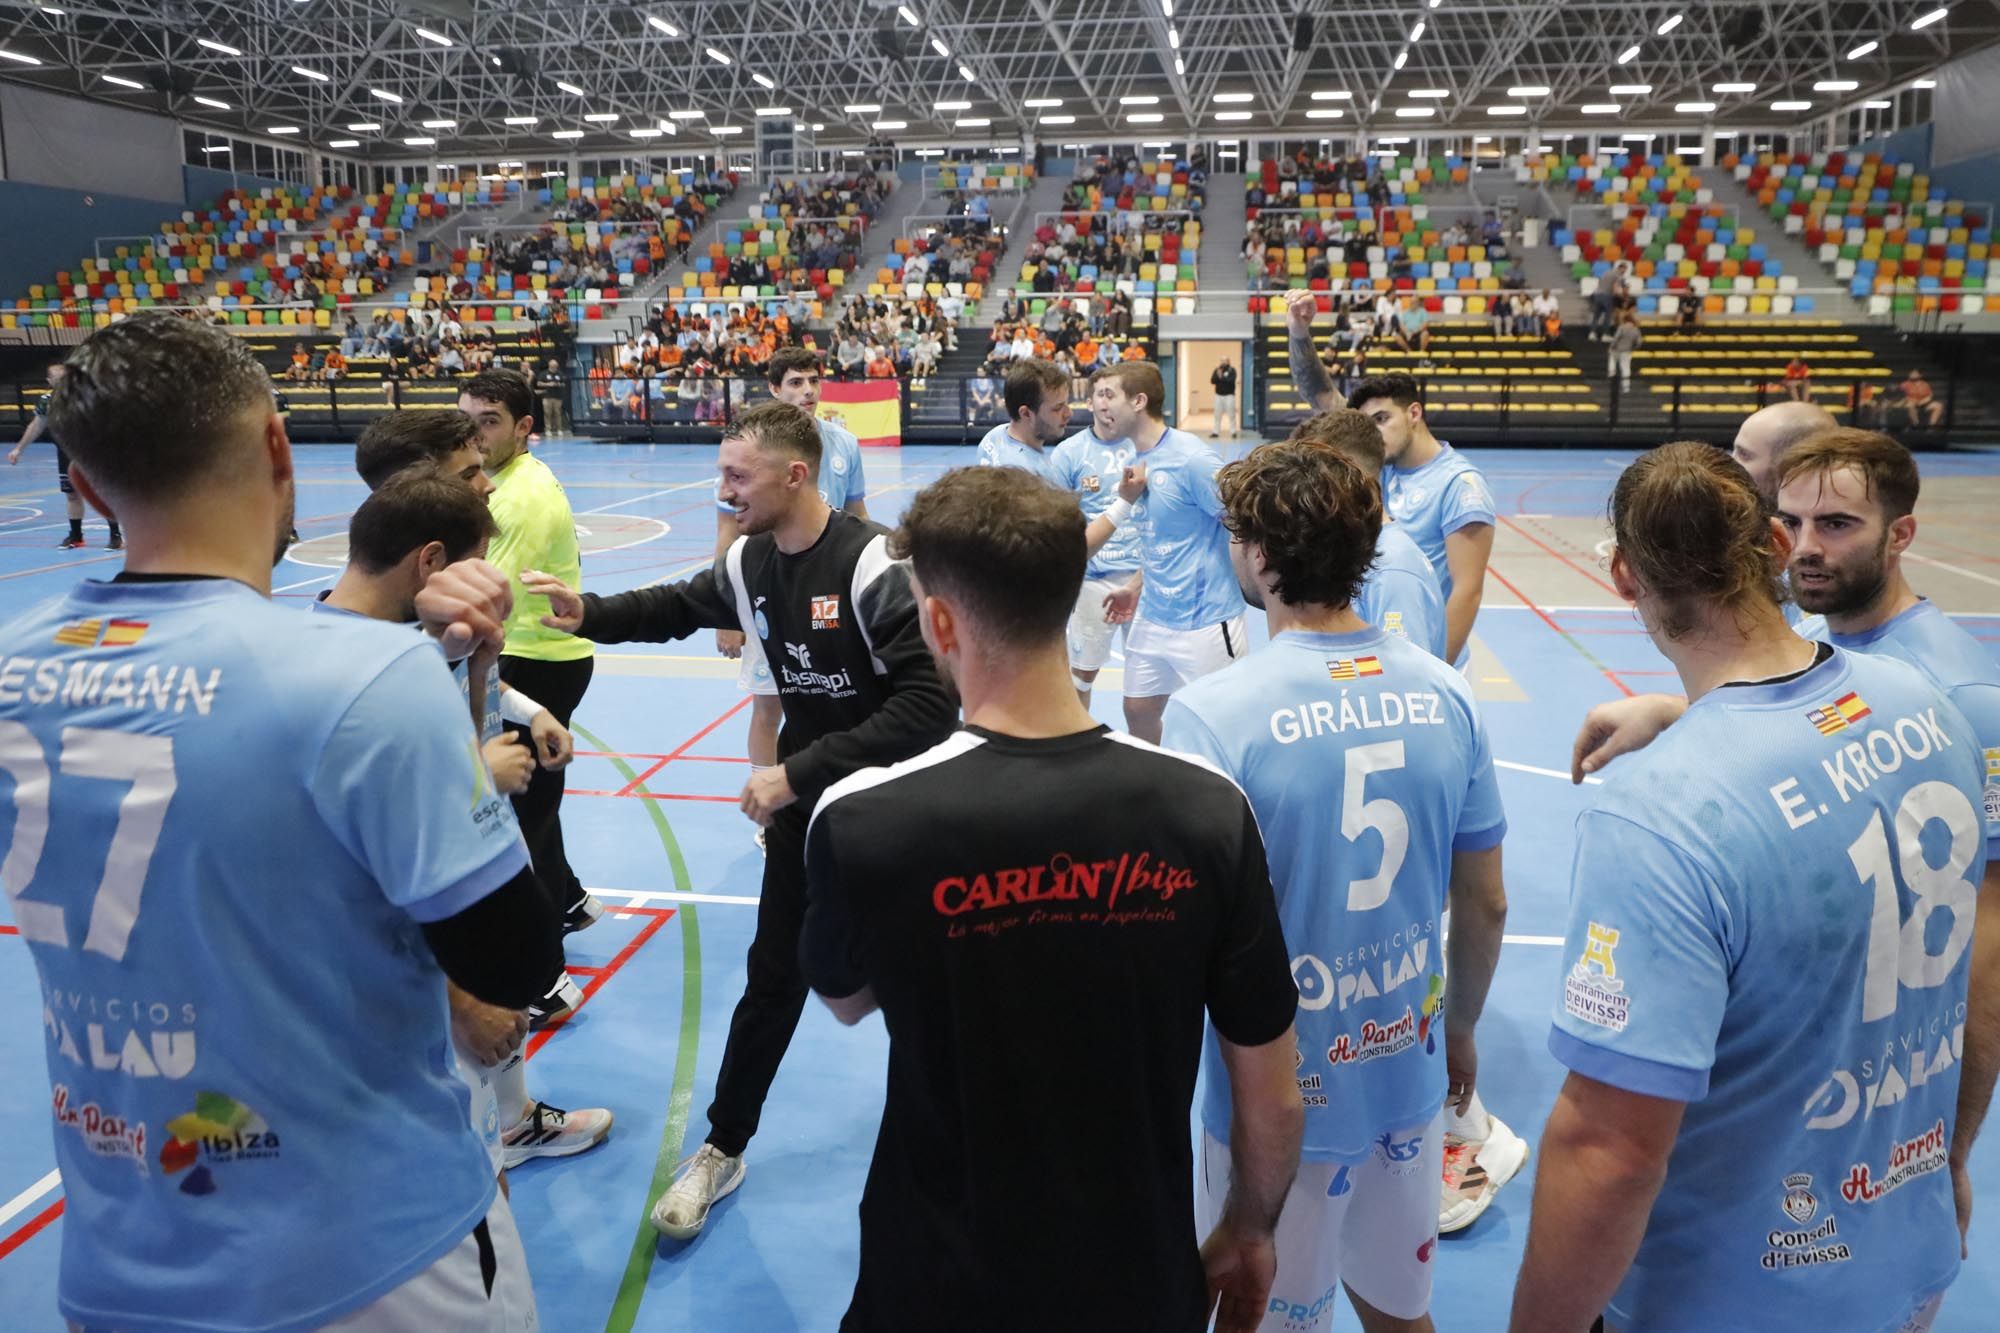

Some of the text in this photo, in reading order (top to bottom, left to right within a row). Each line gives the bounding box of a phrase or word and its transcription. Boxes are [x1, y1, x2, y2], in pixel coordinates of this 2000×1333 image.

[0, 655, 222, 716] ESMANN
[1270, 689, 1445, 744] GIRÁLDEZ
[1769, 707, 1952, 830] E. KROOK
[0, 719, 178, 963] 27
[1341, 739, 1409, 912] 5
[1846, 780, 1980, 1023] 18
[1335, 920, 1433, 972] SERVICIOS
[1362, 1008, 1413, 1046] Parrot
[1297, 1076, 1321, 1089] sell
[1768, 1219, 1836, 1248] Consell
